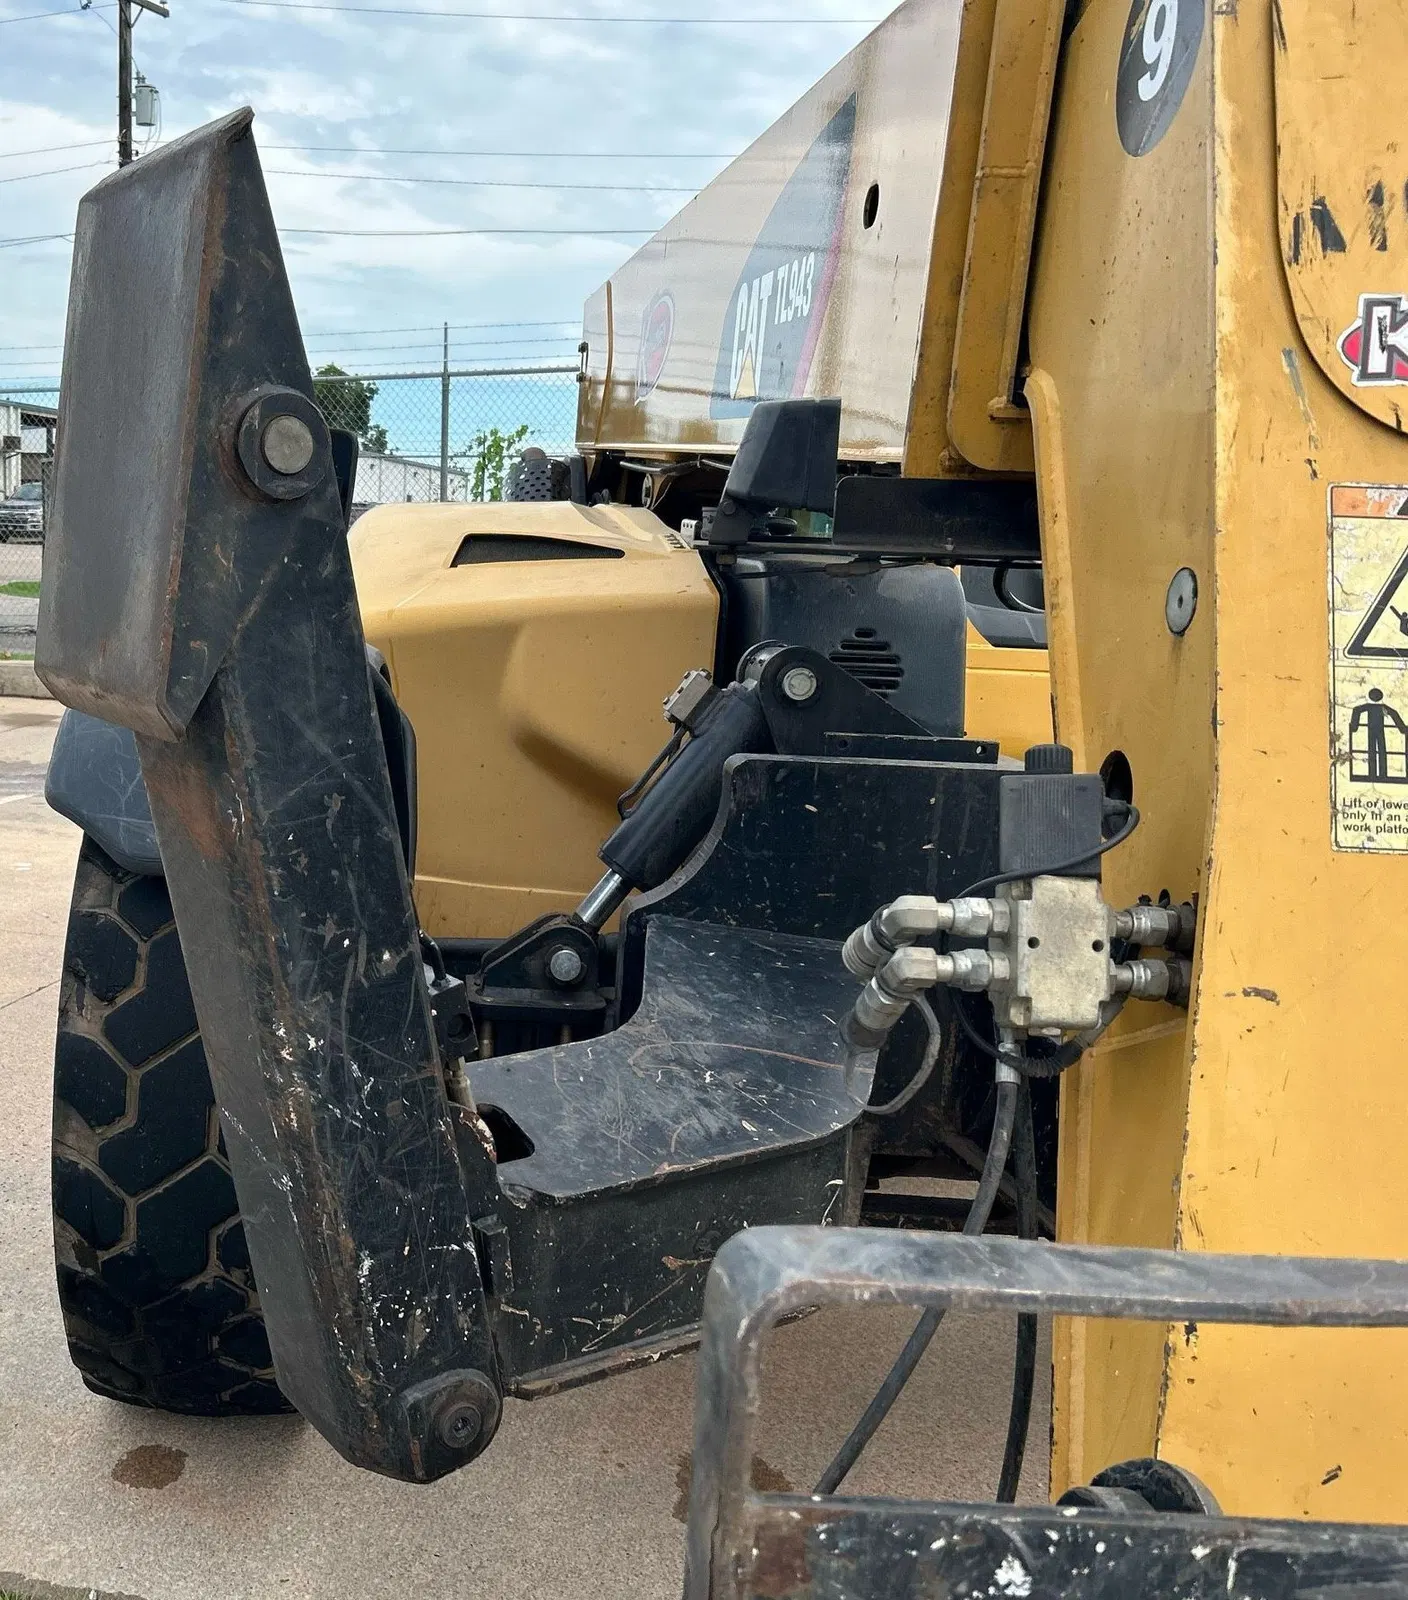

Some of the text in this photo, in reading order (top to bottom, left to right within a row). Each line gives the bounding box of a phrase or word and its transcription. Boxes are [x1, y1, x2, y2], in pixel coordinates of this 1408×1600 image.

[1138, 0, 1178, 101] 9
[730, 252, 815, 399] CAT TL943
[1343, 797, 1361, 808] Lift
[1366, 800, 1379, 808] or
[1343, 810, 1366, 822] only
[1371, 811, 1381, 820] in
[1343, 823, 1371, 832] work
